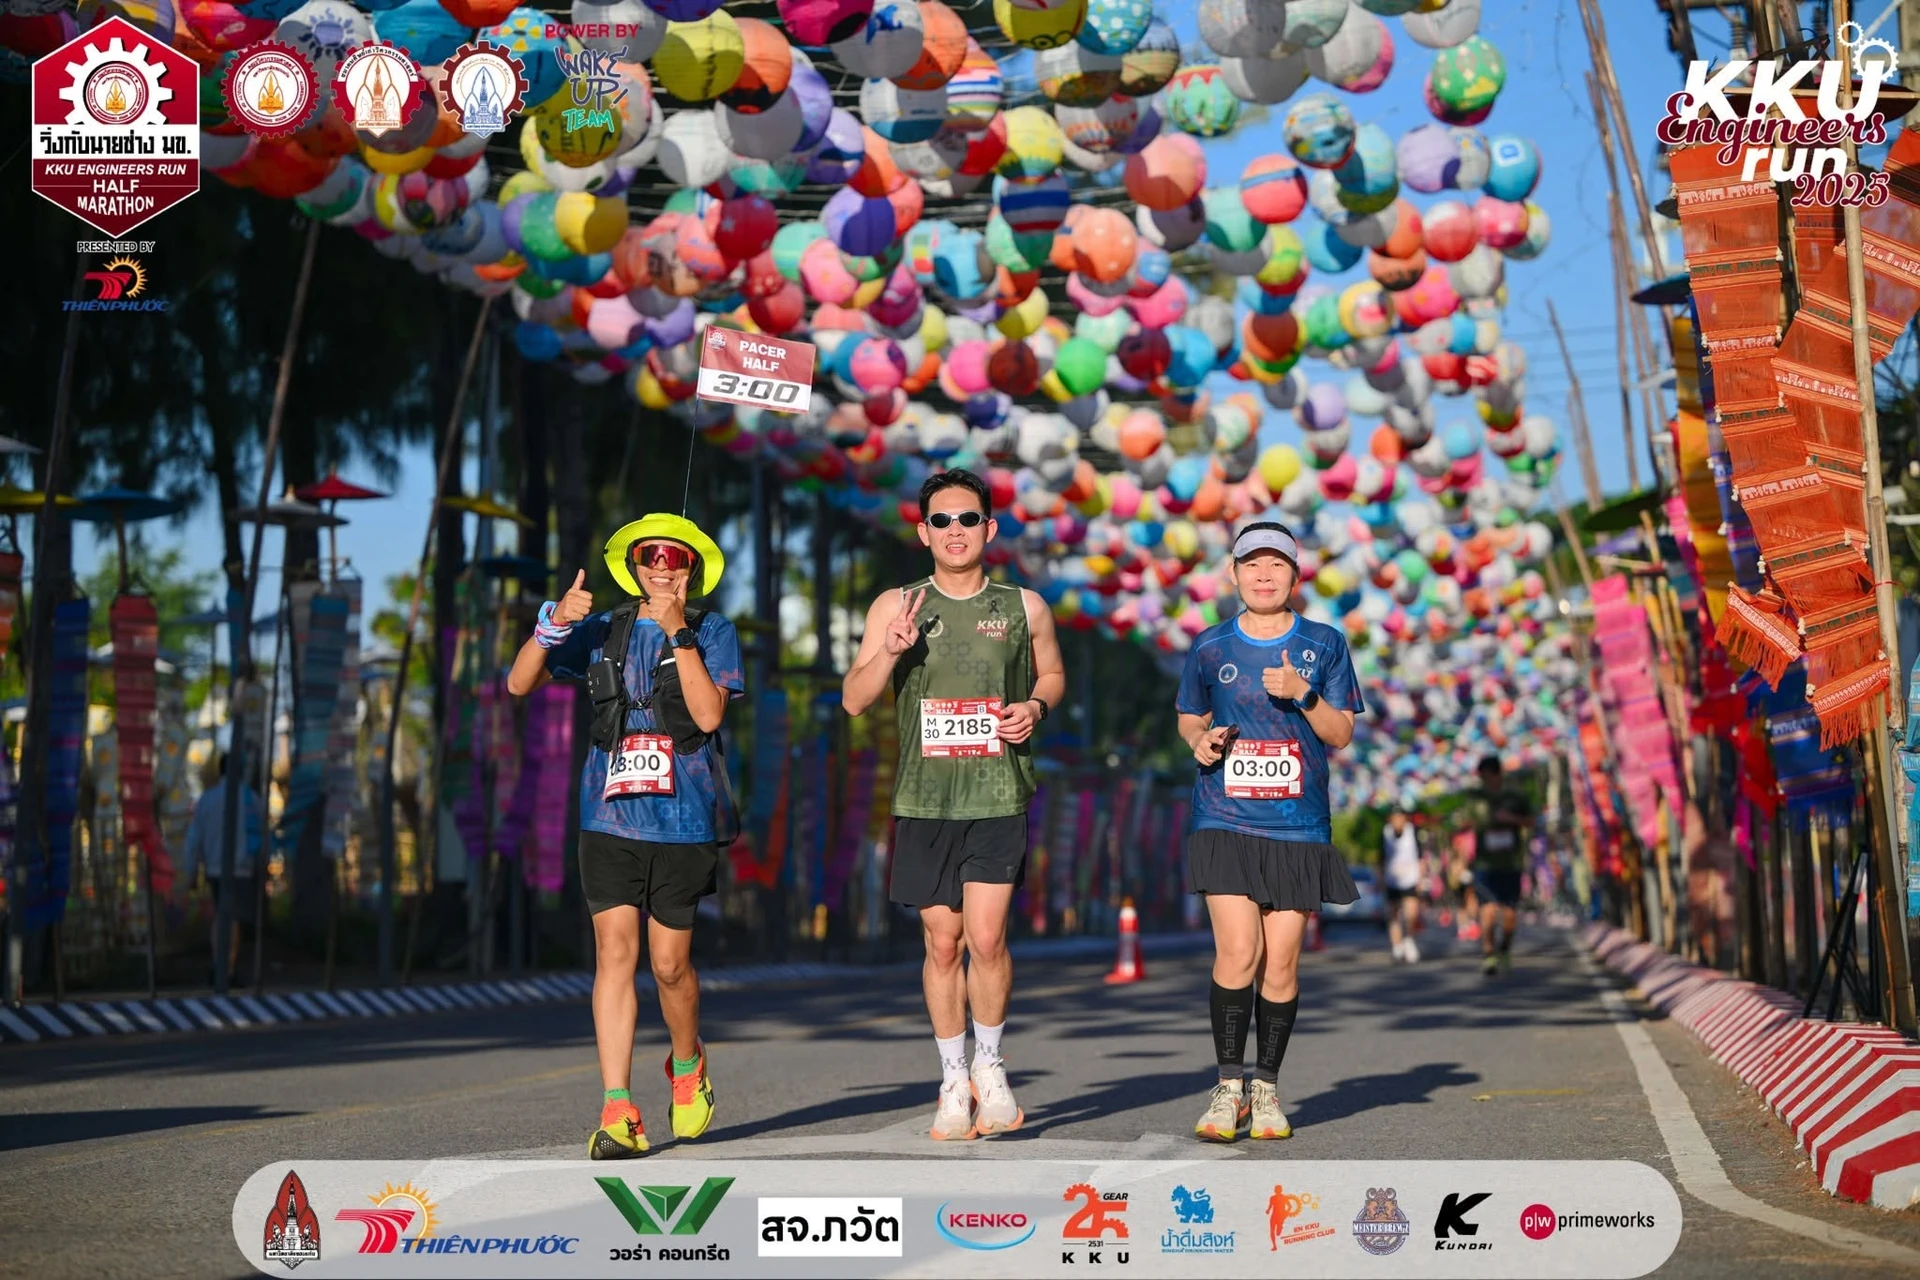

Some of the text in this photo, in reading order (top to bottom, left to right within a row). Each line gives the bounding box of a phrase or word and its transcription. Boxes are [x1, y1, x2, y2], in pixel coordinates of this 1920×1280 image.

[739, 340, 787, 360] PACER
[742, 356, 780, 372] HALF
[712, 373, 800, 404] 3:00
[977, 620, 1007, 630] KKU
[926, 718, 937, 727] M
[944, 718, 992, 736] 2185
[924, 729, 940, 739] 30
[1232, 760, 1291, 777] 03:00
